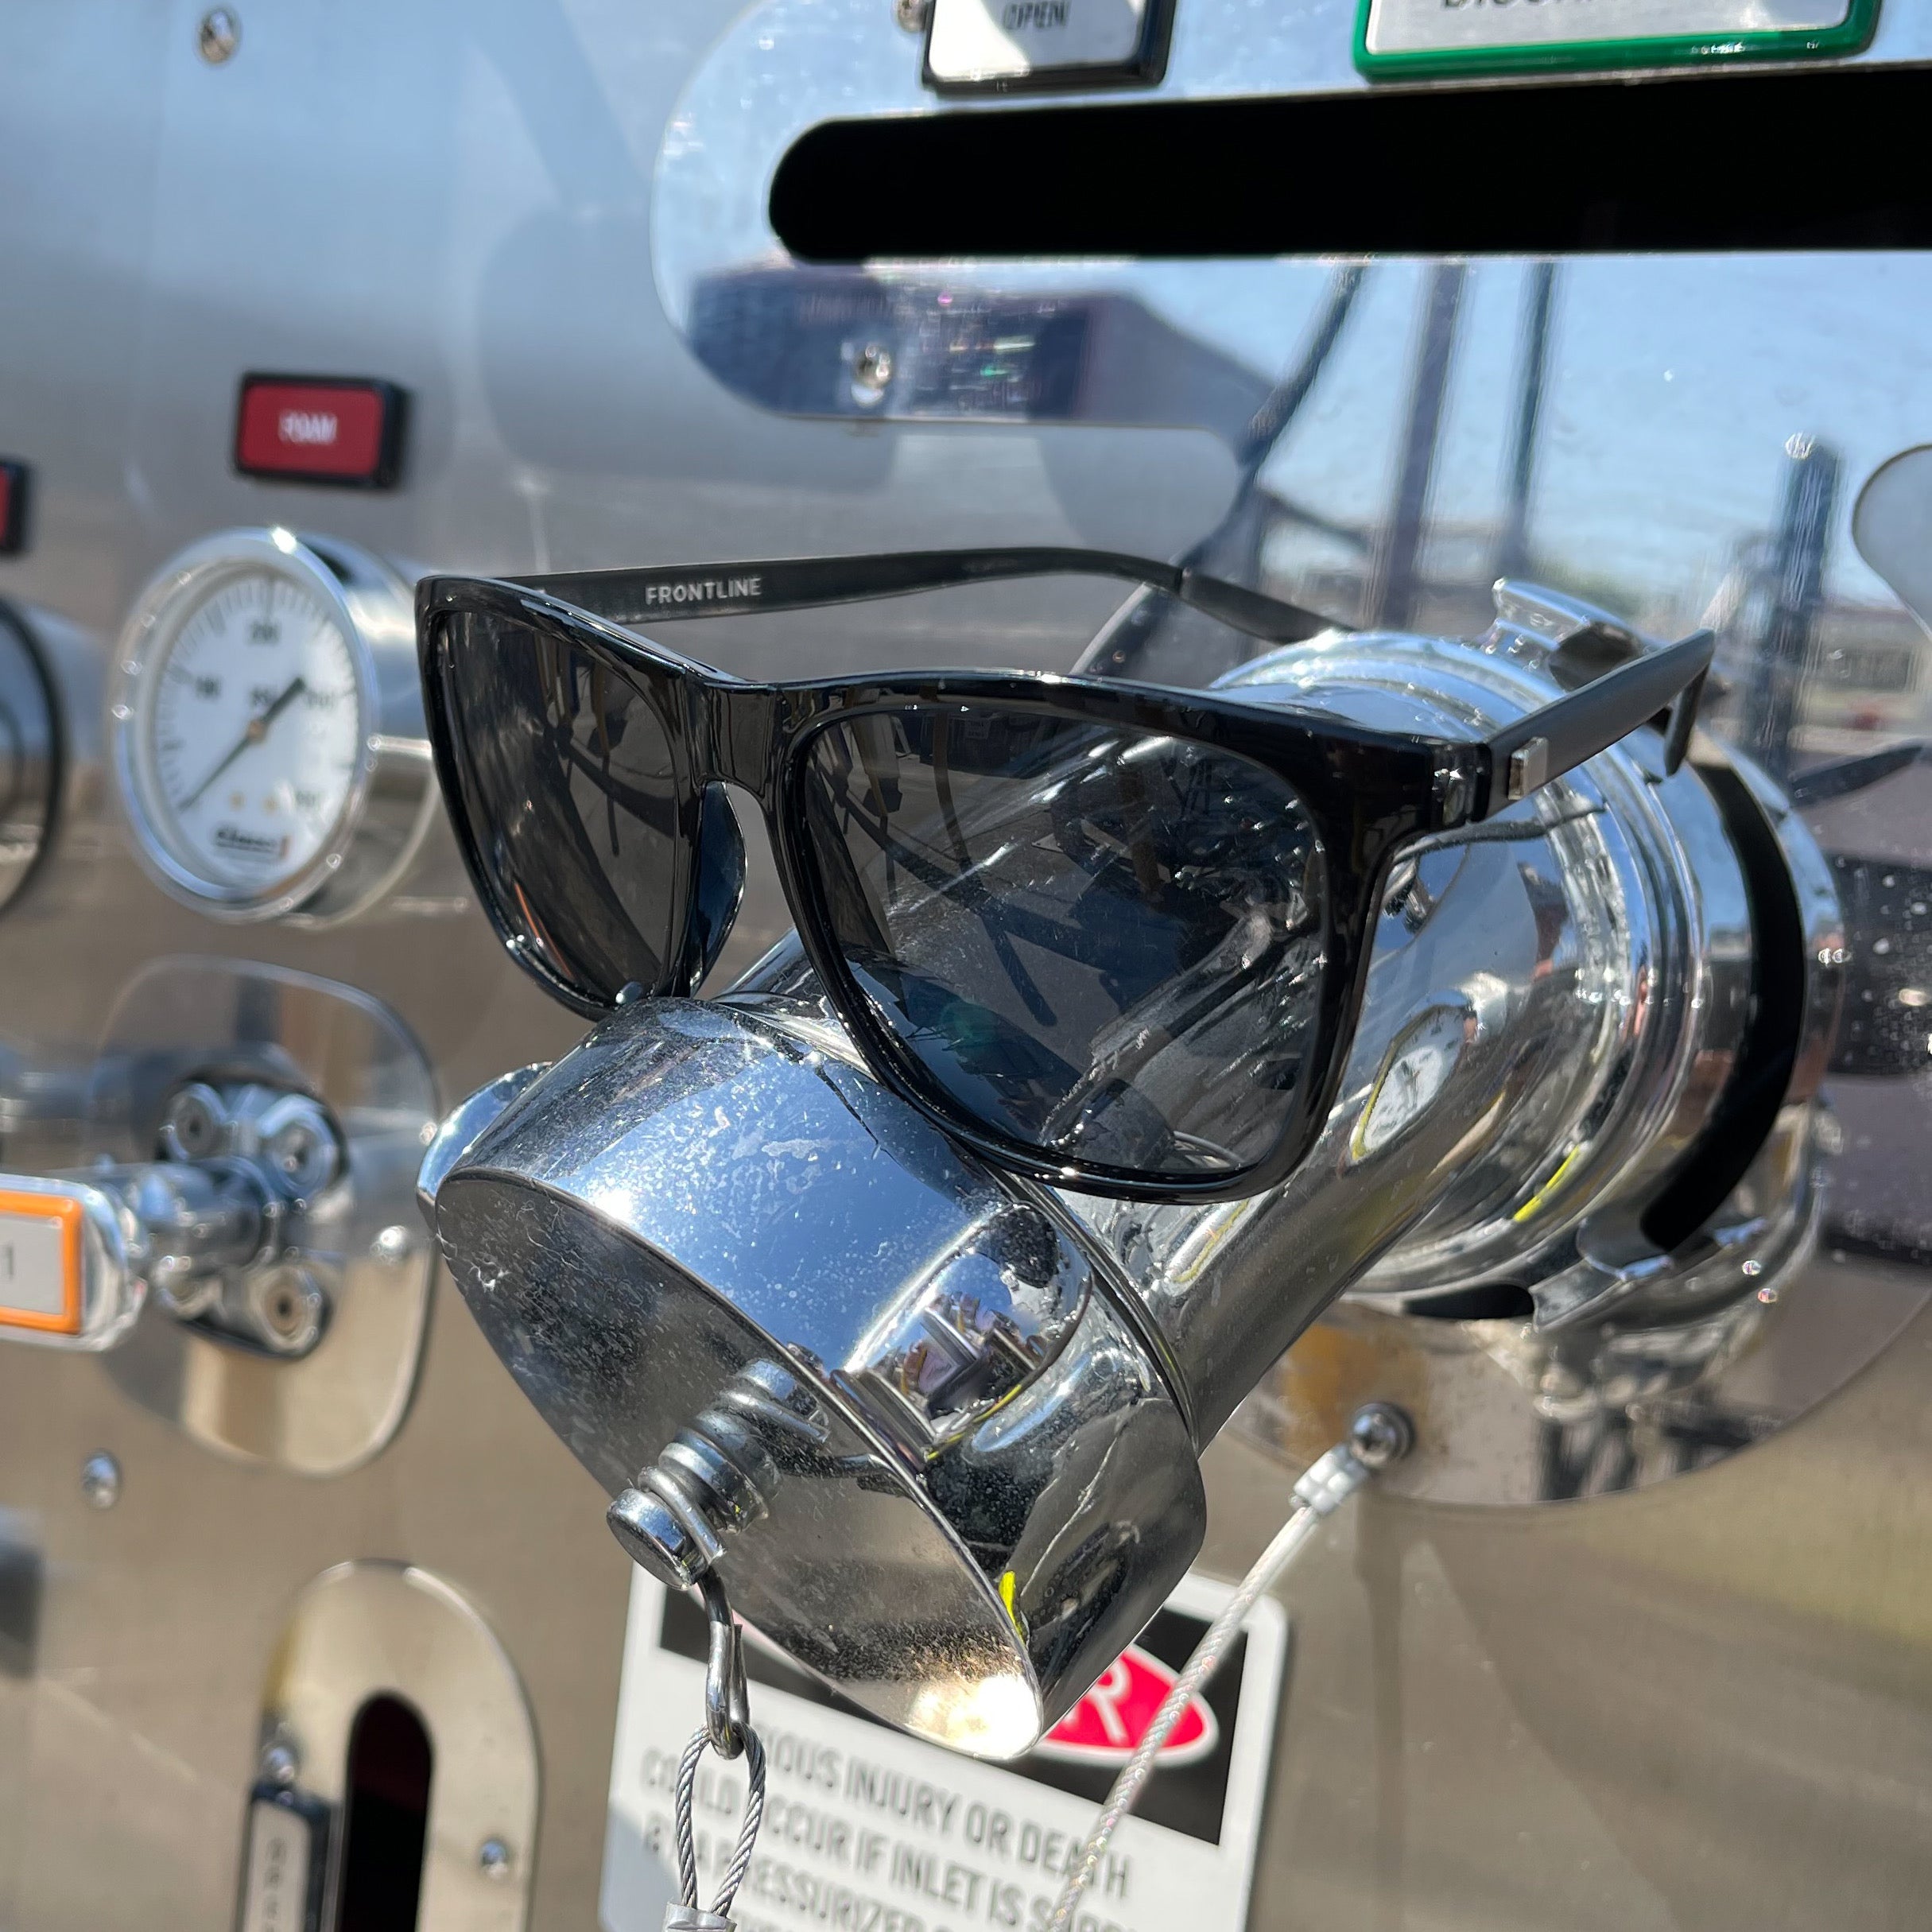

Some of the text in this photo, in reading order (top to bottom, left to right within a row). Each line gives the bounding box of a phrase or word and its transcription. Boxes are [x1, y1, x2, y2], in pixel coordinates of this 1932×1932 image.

[645, 577, 762, 605] FRONTLINE
[641, 1747, 742, 1818] COLD
[754, 1793, 852, 1853] CCUR
[855, 1825, 891, 1872] IF
[889, 1838, 984, 1912] INLET
[988, 1876, 1022, 1926] IS
[844, 1756, 962, 1834] INJURY
[964, 1800, 1014, 1851] OR
[1019, 1820, 1132, 1899] DEAH
